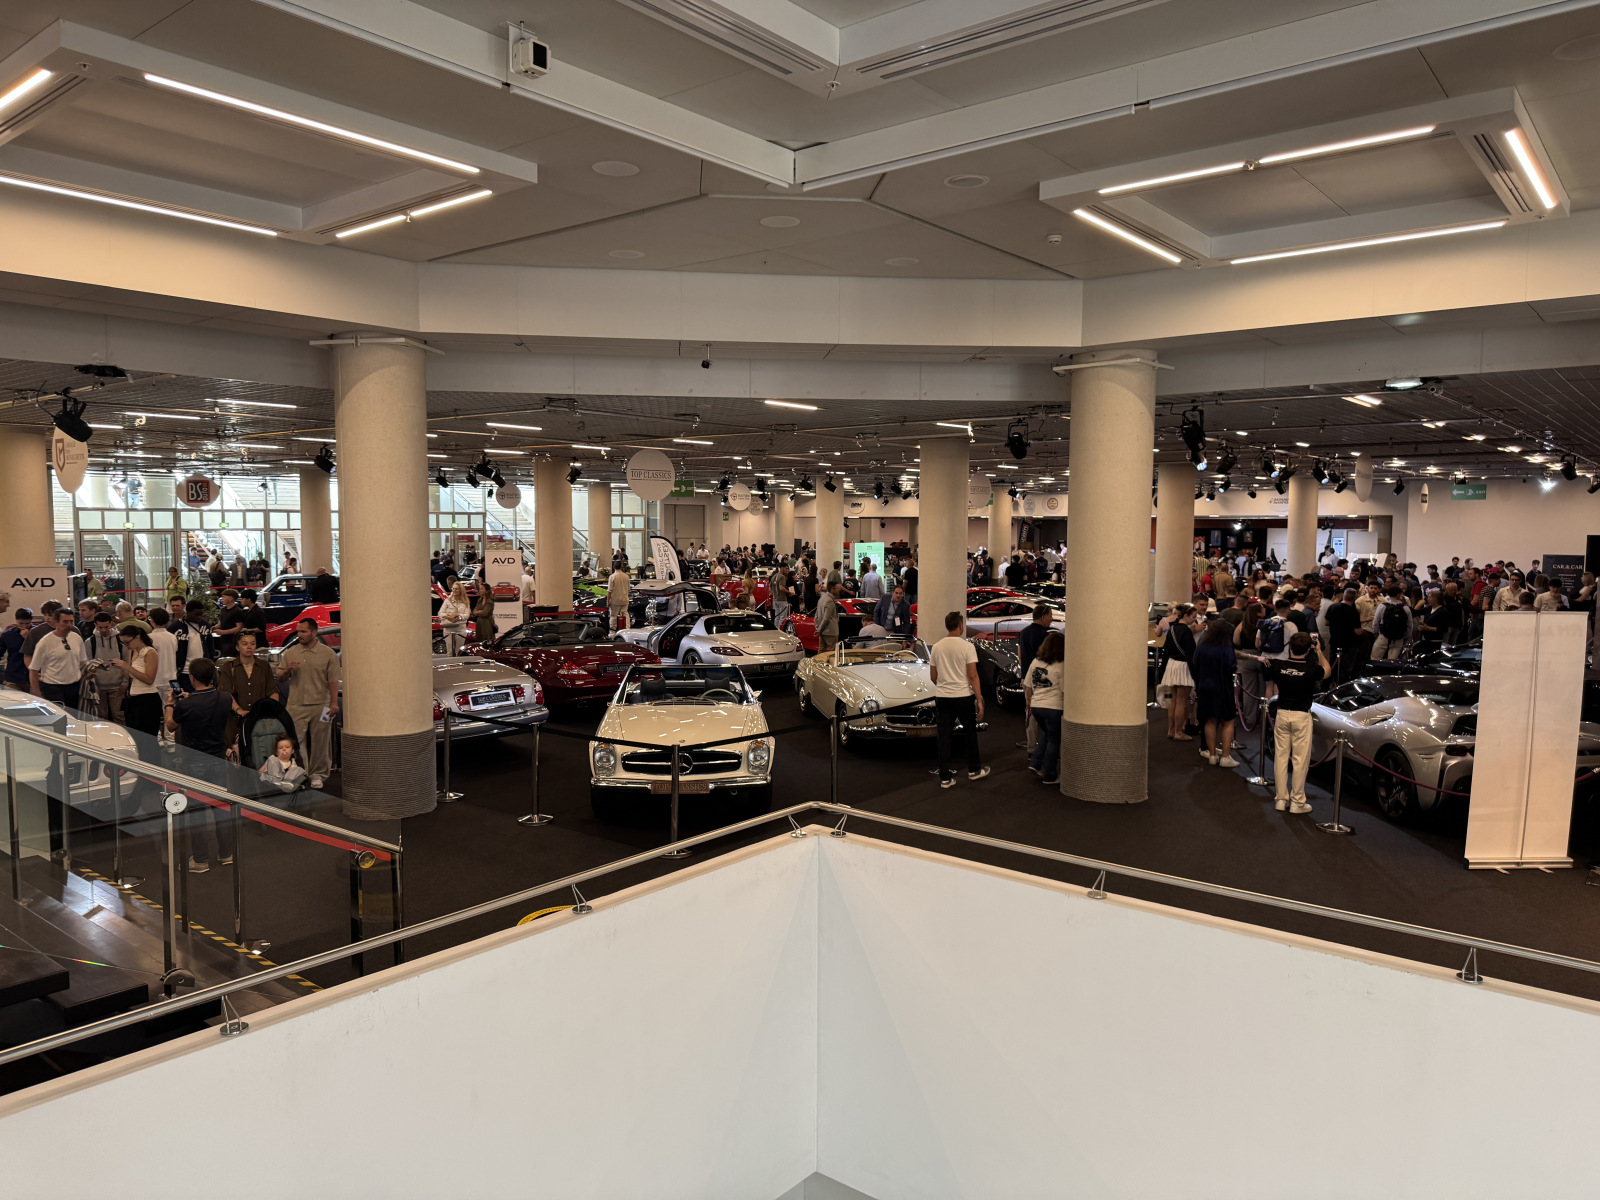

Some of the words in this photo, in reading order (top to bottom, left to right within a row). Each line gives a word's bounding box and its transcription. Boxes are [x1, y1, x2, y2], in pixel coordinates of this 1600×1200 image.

[644, 471, 672, 479] CLASSICS
[188, 482, 203, 501] BS
[492, 557, 516, 565] AVD
[11, 577, 56, 588] AVD
